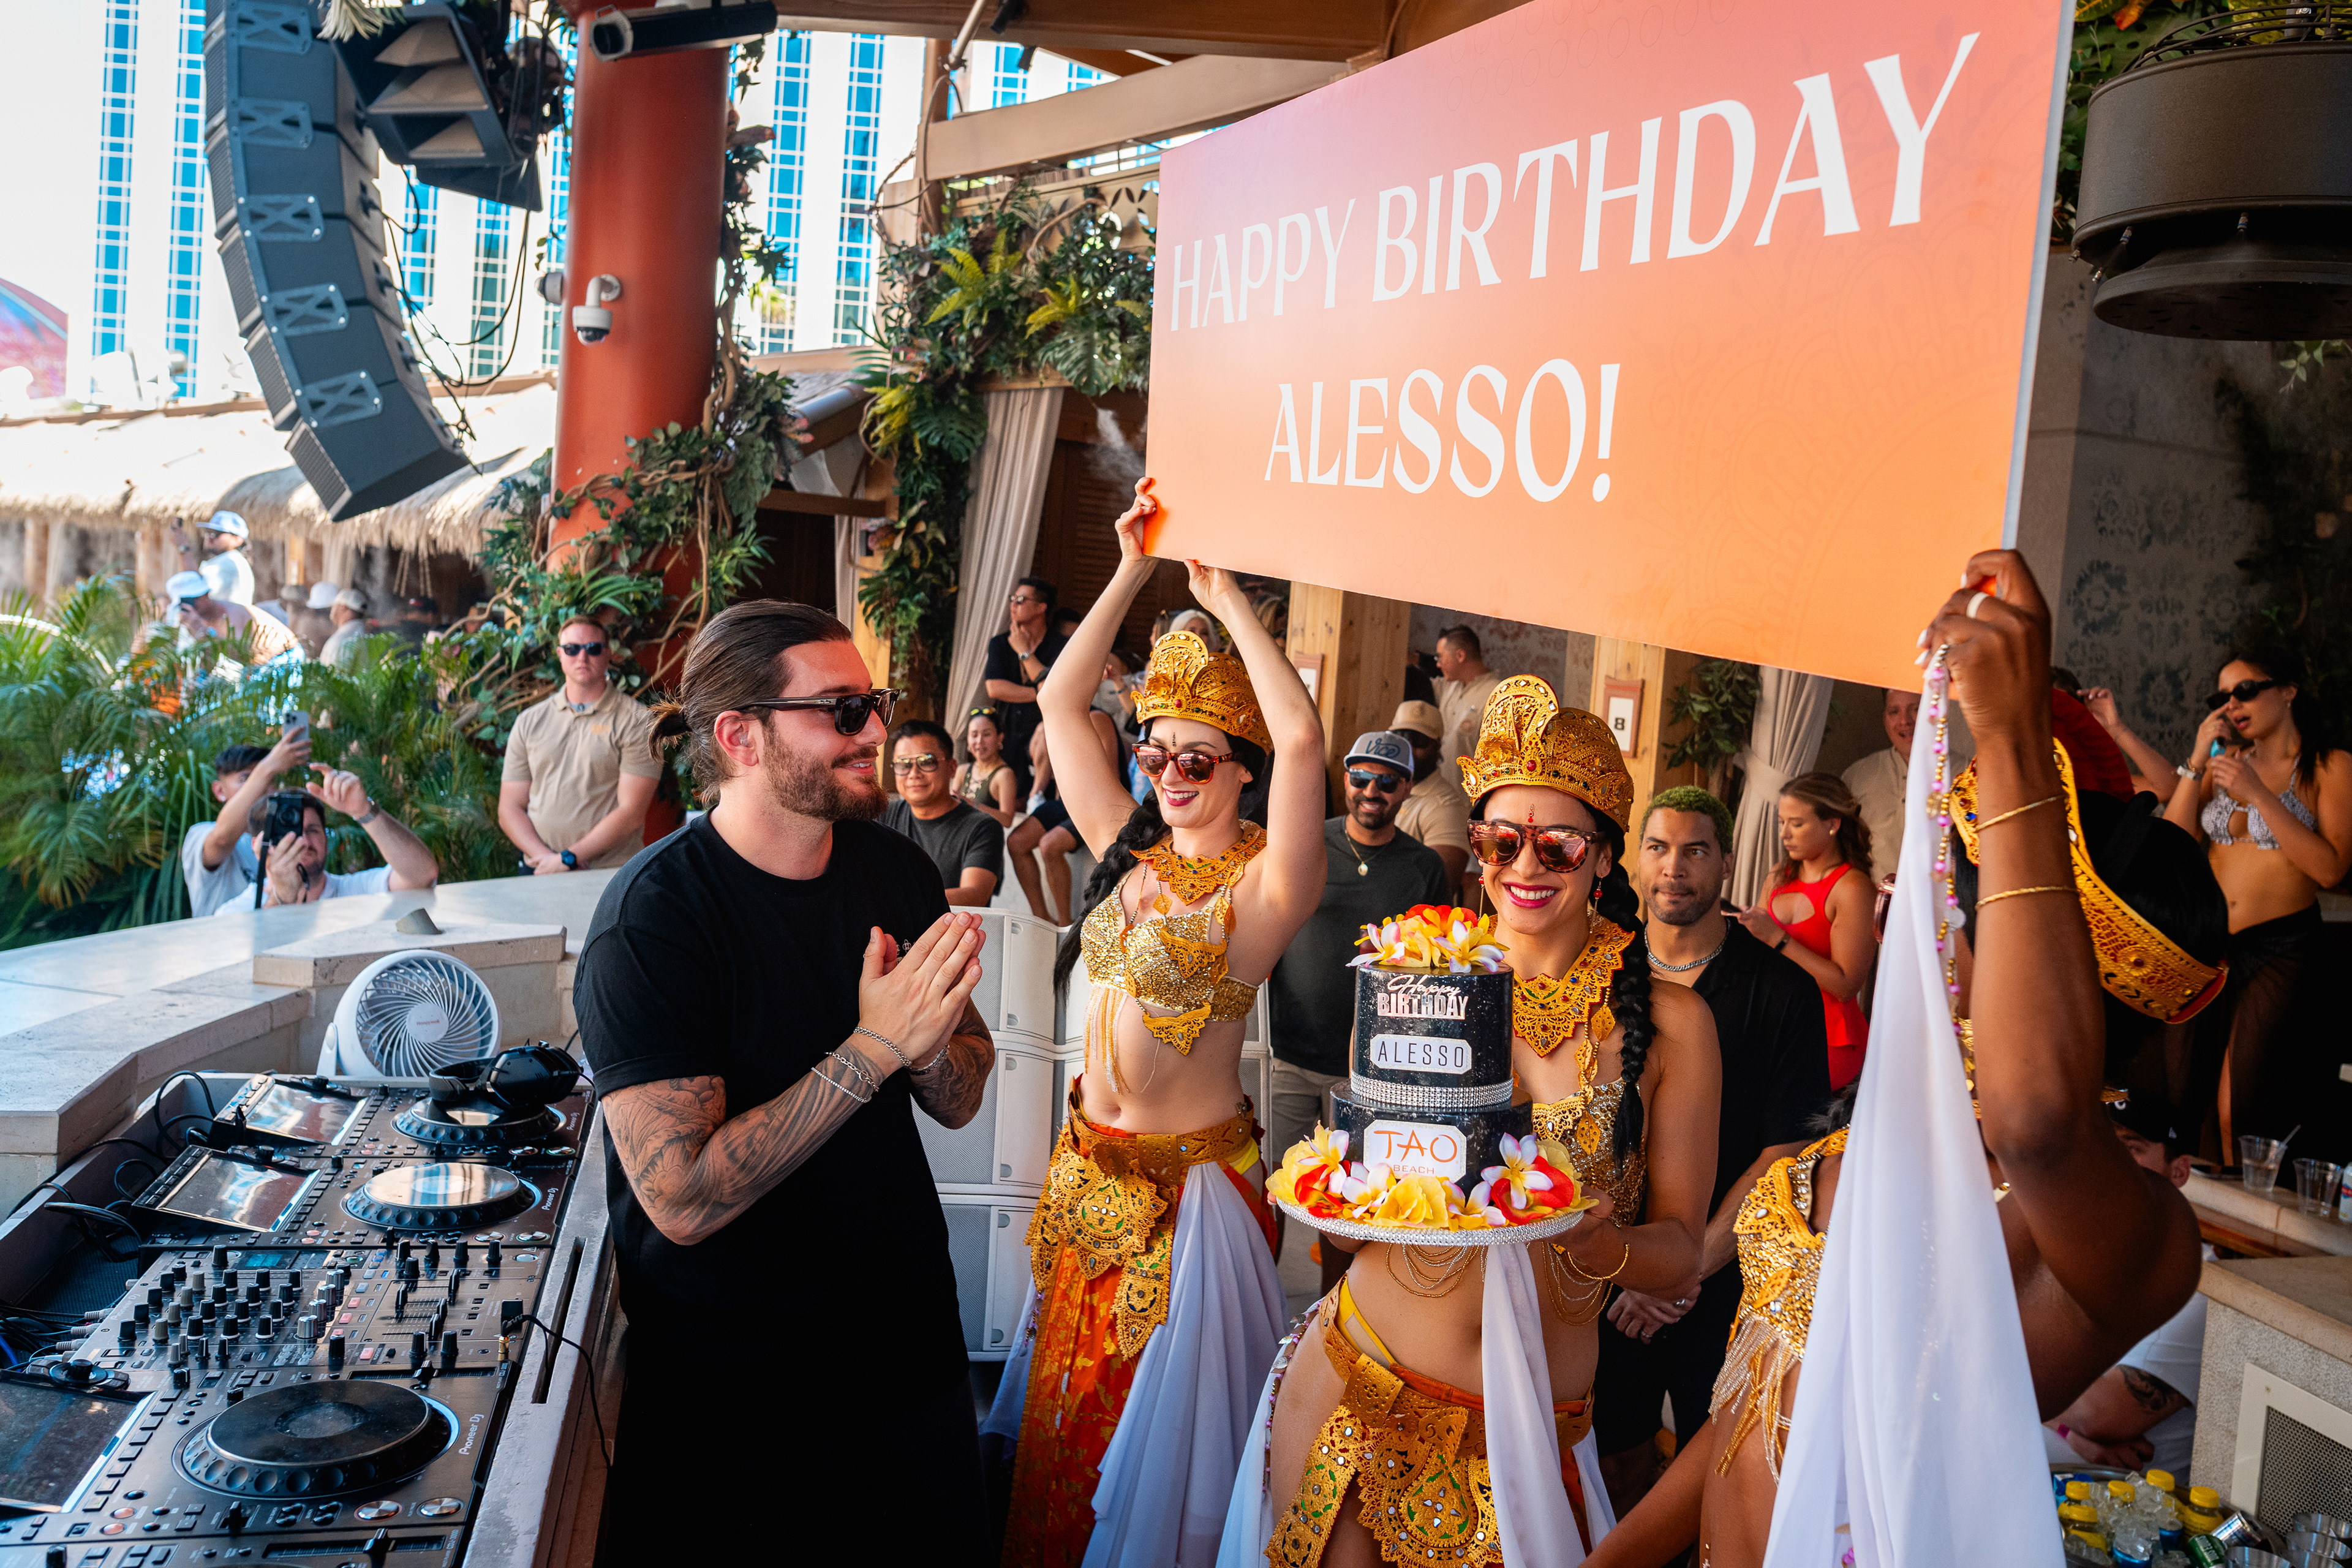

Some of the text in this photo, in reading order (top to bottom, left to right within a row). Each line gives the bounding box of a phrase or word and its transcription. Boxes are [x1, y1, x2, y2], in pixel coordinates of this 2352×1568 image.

[1170, 32, 1980, 332] HAPPY BIRTHDAY
[1264, 359, 1621, 502] ALESSO!
[1614, 717, 1625, 731] 8
[1365, 737, 1401, 758] Vice
[1387, 974, 1461, 997] Happy
[1378, 992, 1468, 1020] BIRTHDAY
[1378, 1041, 1464, 1068] ALESSO
[1373, 1129, 1457, 1163] TAO
[1393, 1164, 1434, 1175] BEACH
[459, 1423, 478, 1455] Pioneer
